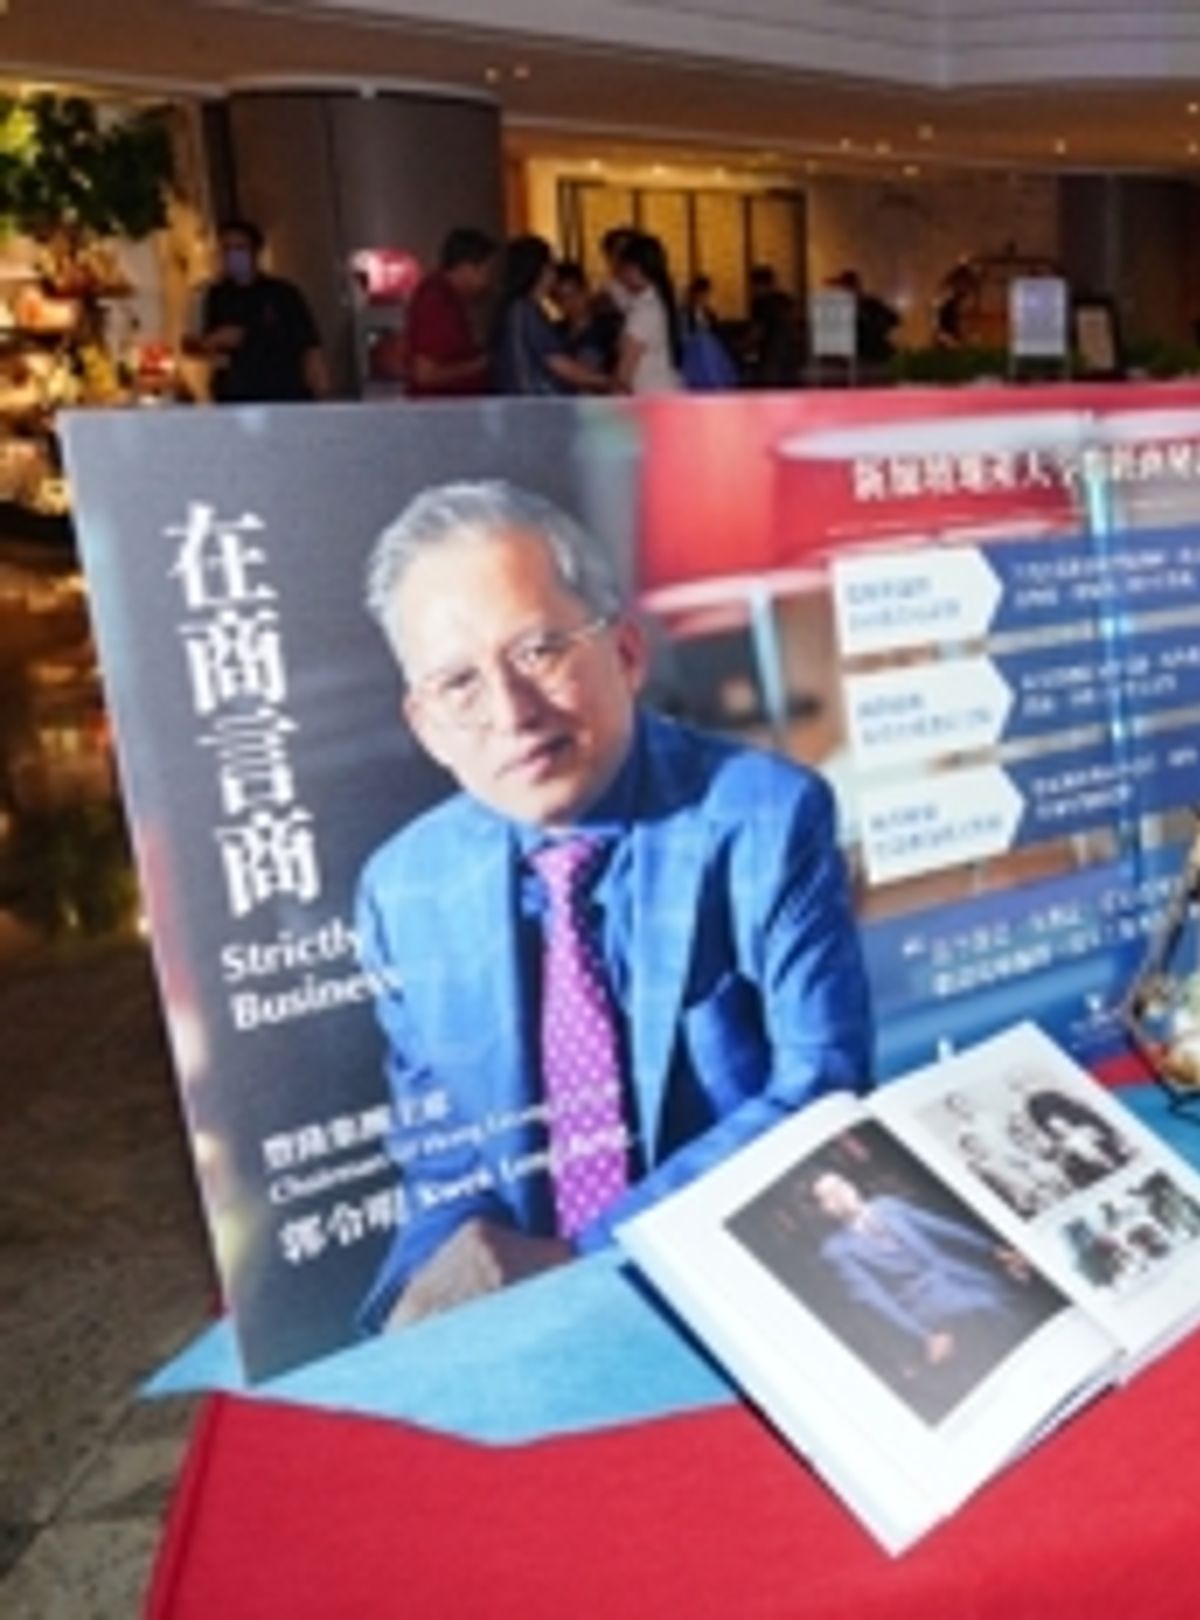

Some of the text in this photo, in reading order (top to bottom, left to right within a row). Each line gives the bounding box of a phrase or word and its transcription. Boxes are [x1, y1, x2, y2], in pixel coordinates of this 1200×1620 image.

[162, 500, 322, 918] 在商言商
[221, 917, 366, 983] Strictly
